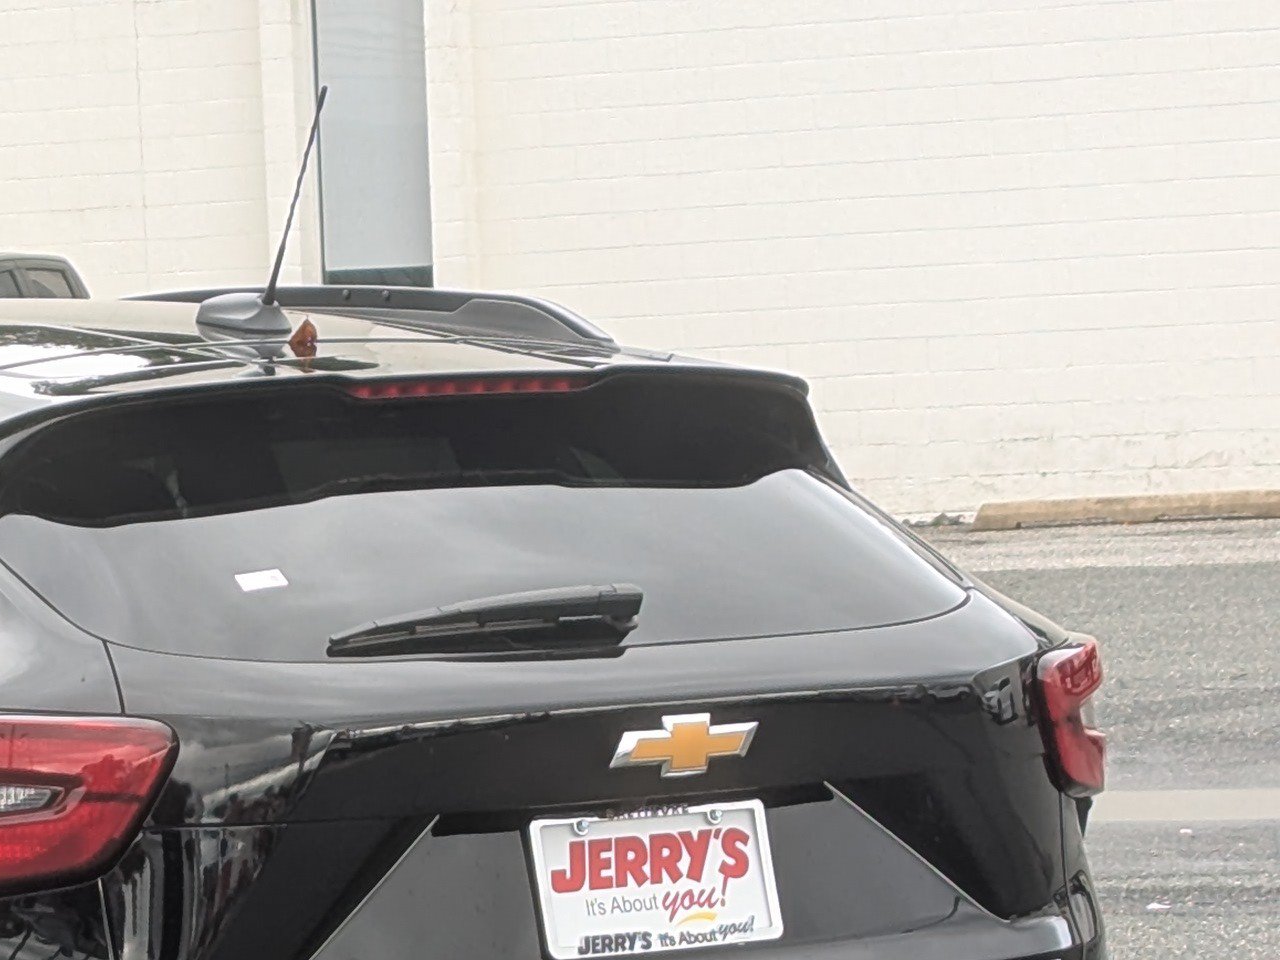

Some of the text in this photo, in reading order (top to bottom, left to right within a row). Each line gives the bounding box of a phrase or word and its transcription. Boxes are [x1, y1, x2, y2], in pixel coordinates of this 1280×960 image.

[551, 828, 750, 893] JERRY'S
[585, 876, 726, 923] It's About you!
[577, 931, 653, 955] JERRY'S
[658, 915, 755, 948] It's About you!
